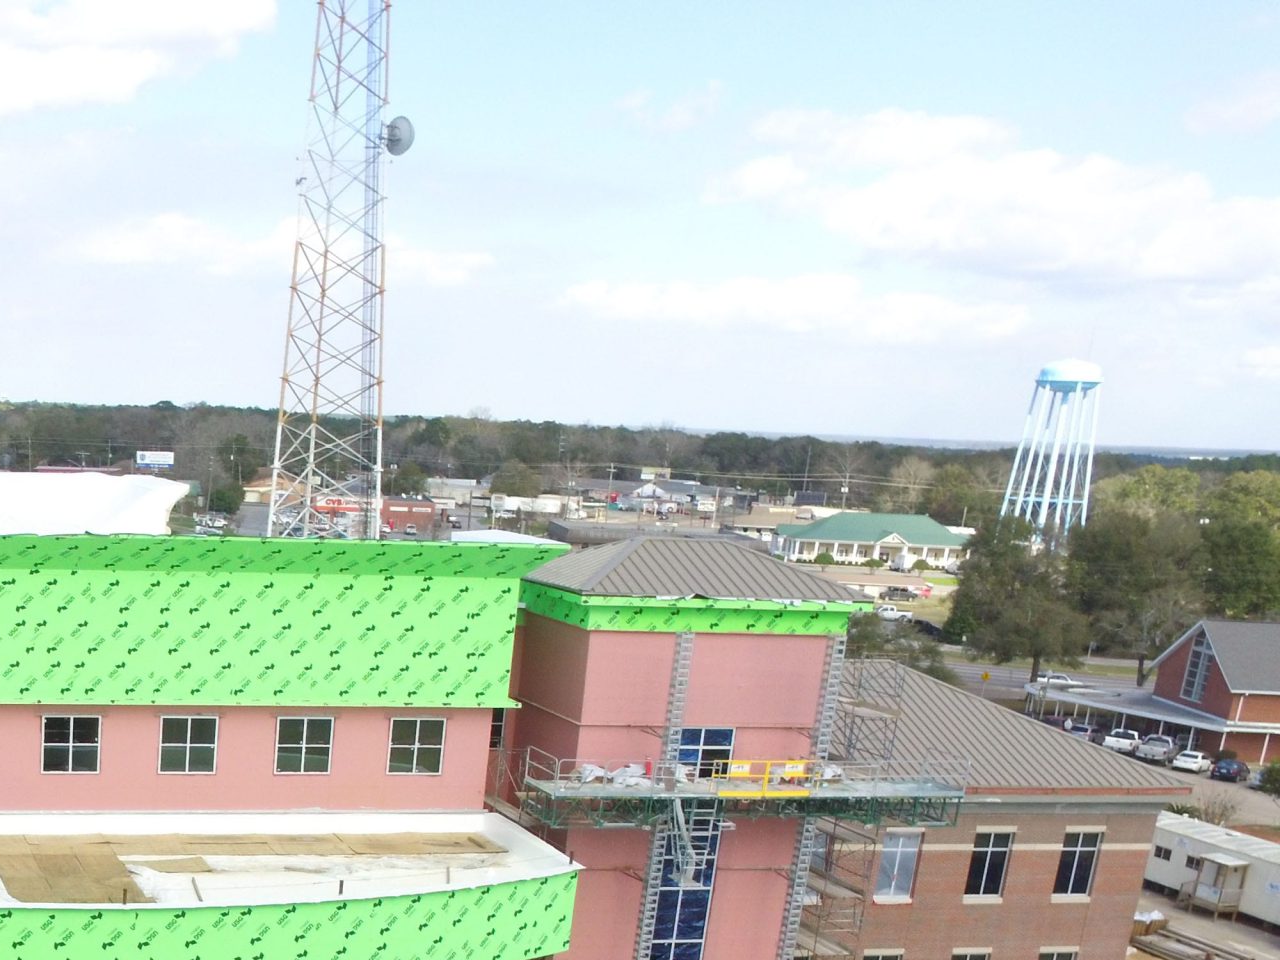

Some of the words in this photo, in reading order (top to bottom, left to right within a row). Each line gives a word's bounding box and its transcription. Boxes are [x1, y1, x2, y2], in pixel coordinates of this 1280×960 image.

[231, 916, 243, 926] USG
[277, 914, 288, 924] USG
[328, 911, 339, 921] USG
[40, 920, 52, 930] USG
[81, 920, 93, 930] USG
[165, 919, 177, 929] USG
[212, 917, 224, 927] USG
[353, 920, 363, 930] USG
[387, 916, 398, 927] USG
[194, 929, 205, 939] USG
[259, 926, 270, 936] USG
[303, 924, 313, 934] USG
[21, 930, 33, 941] USG
[63, 931, 74, 941] USG
[111, 931, 123, 941] USG
[147, 931, 158, 941] USG
[426, 944, 435, 954] USG
[368, 951, 379, 960] USG
